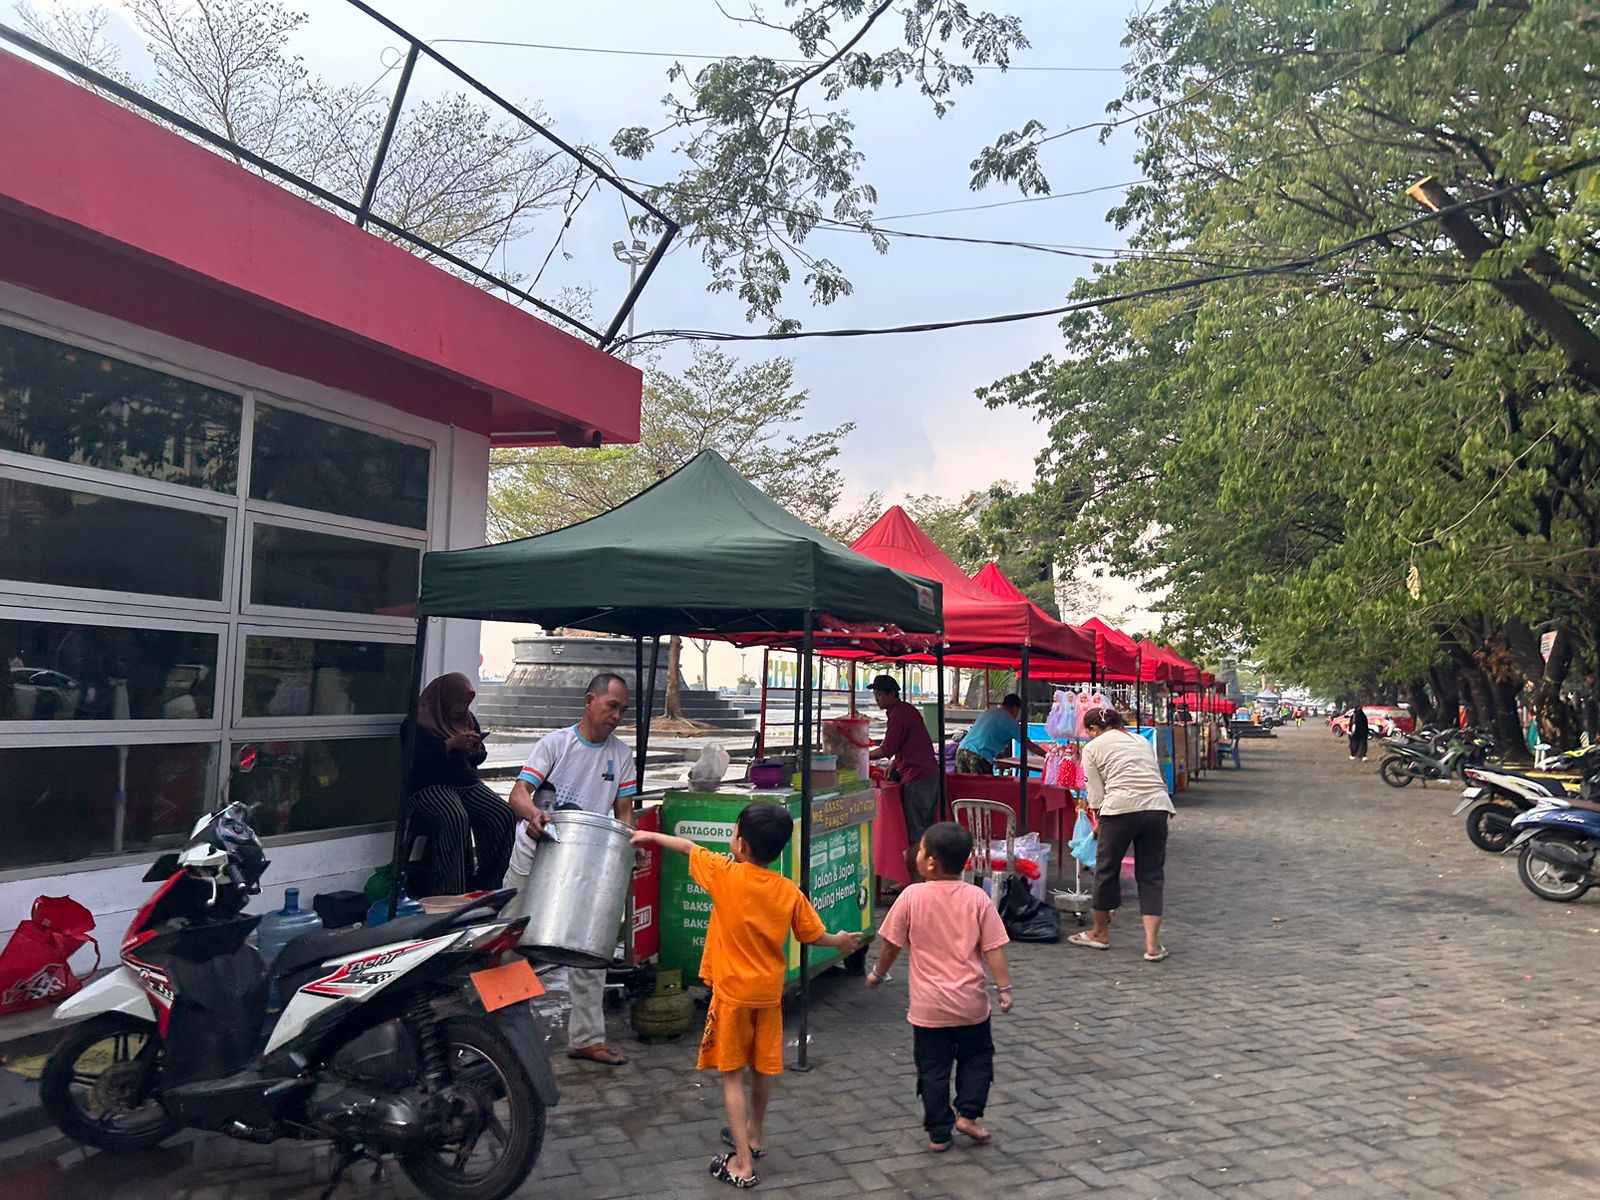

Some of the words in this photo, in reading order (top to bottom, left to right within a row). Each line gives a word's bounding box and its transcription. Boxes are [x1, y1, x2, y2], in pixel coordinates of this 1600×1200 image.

[680, 825, 724, 837] BATAGOR
[814, 871, 833, 890] Jalan
[839, 862, 855, 880] Jajan
[813, 891, 835, 910] Paling
[836, 880, 856, 902] Hemat
